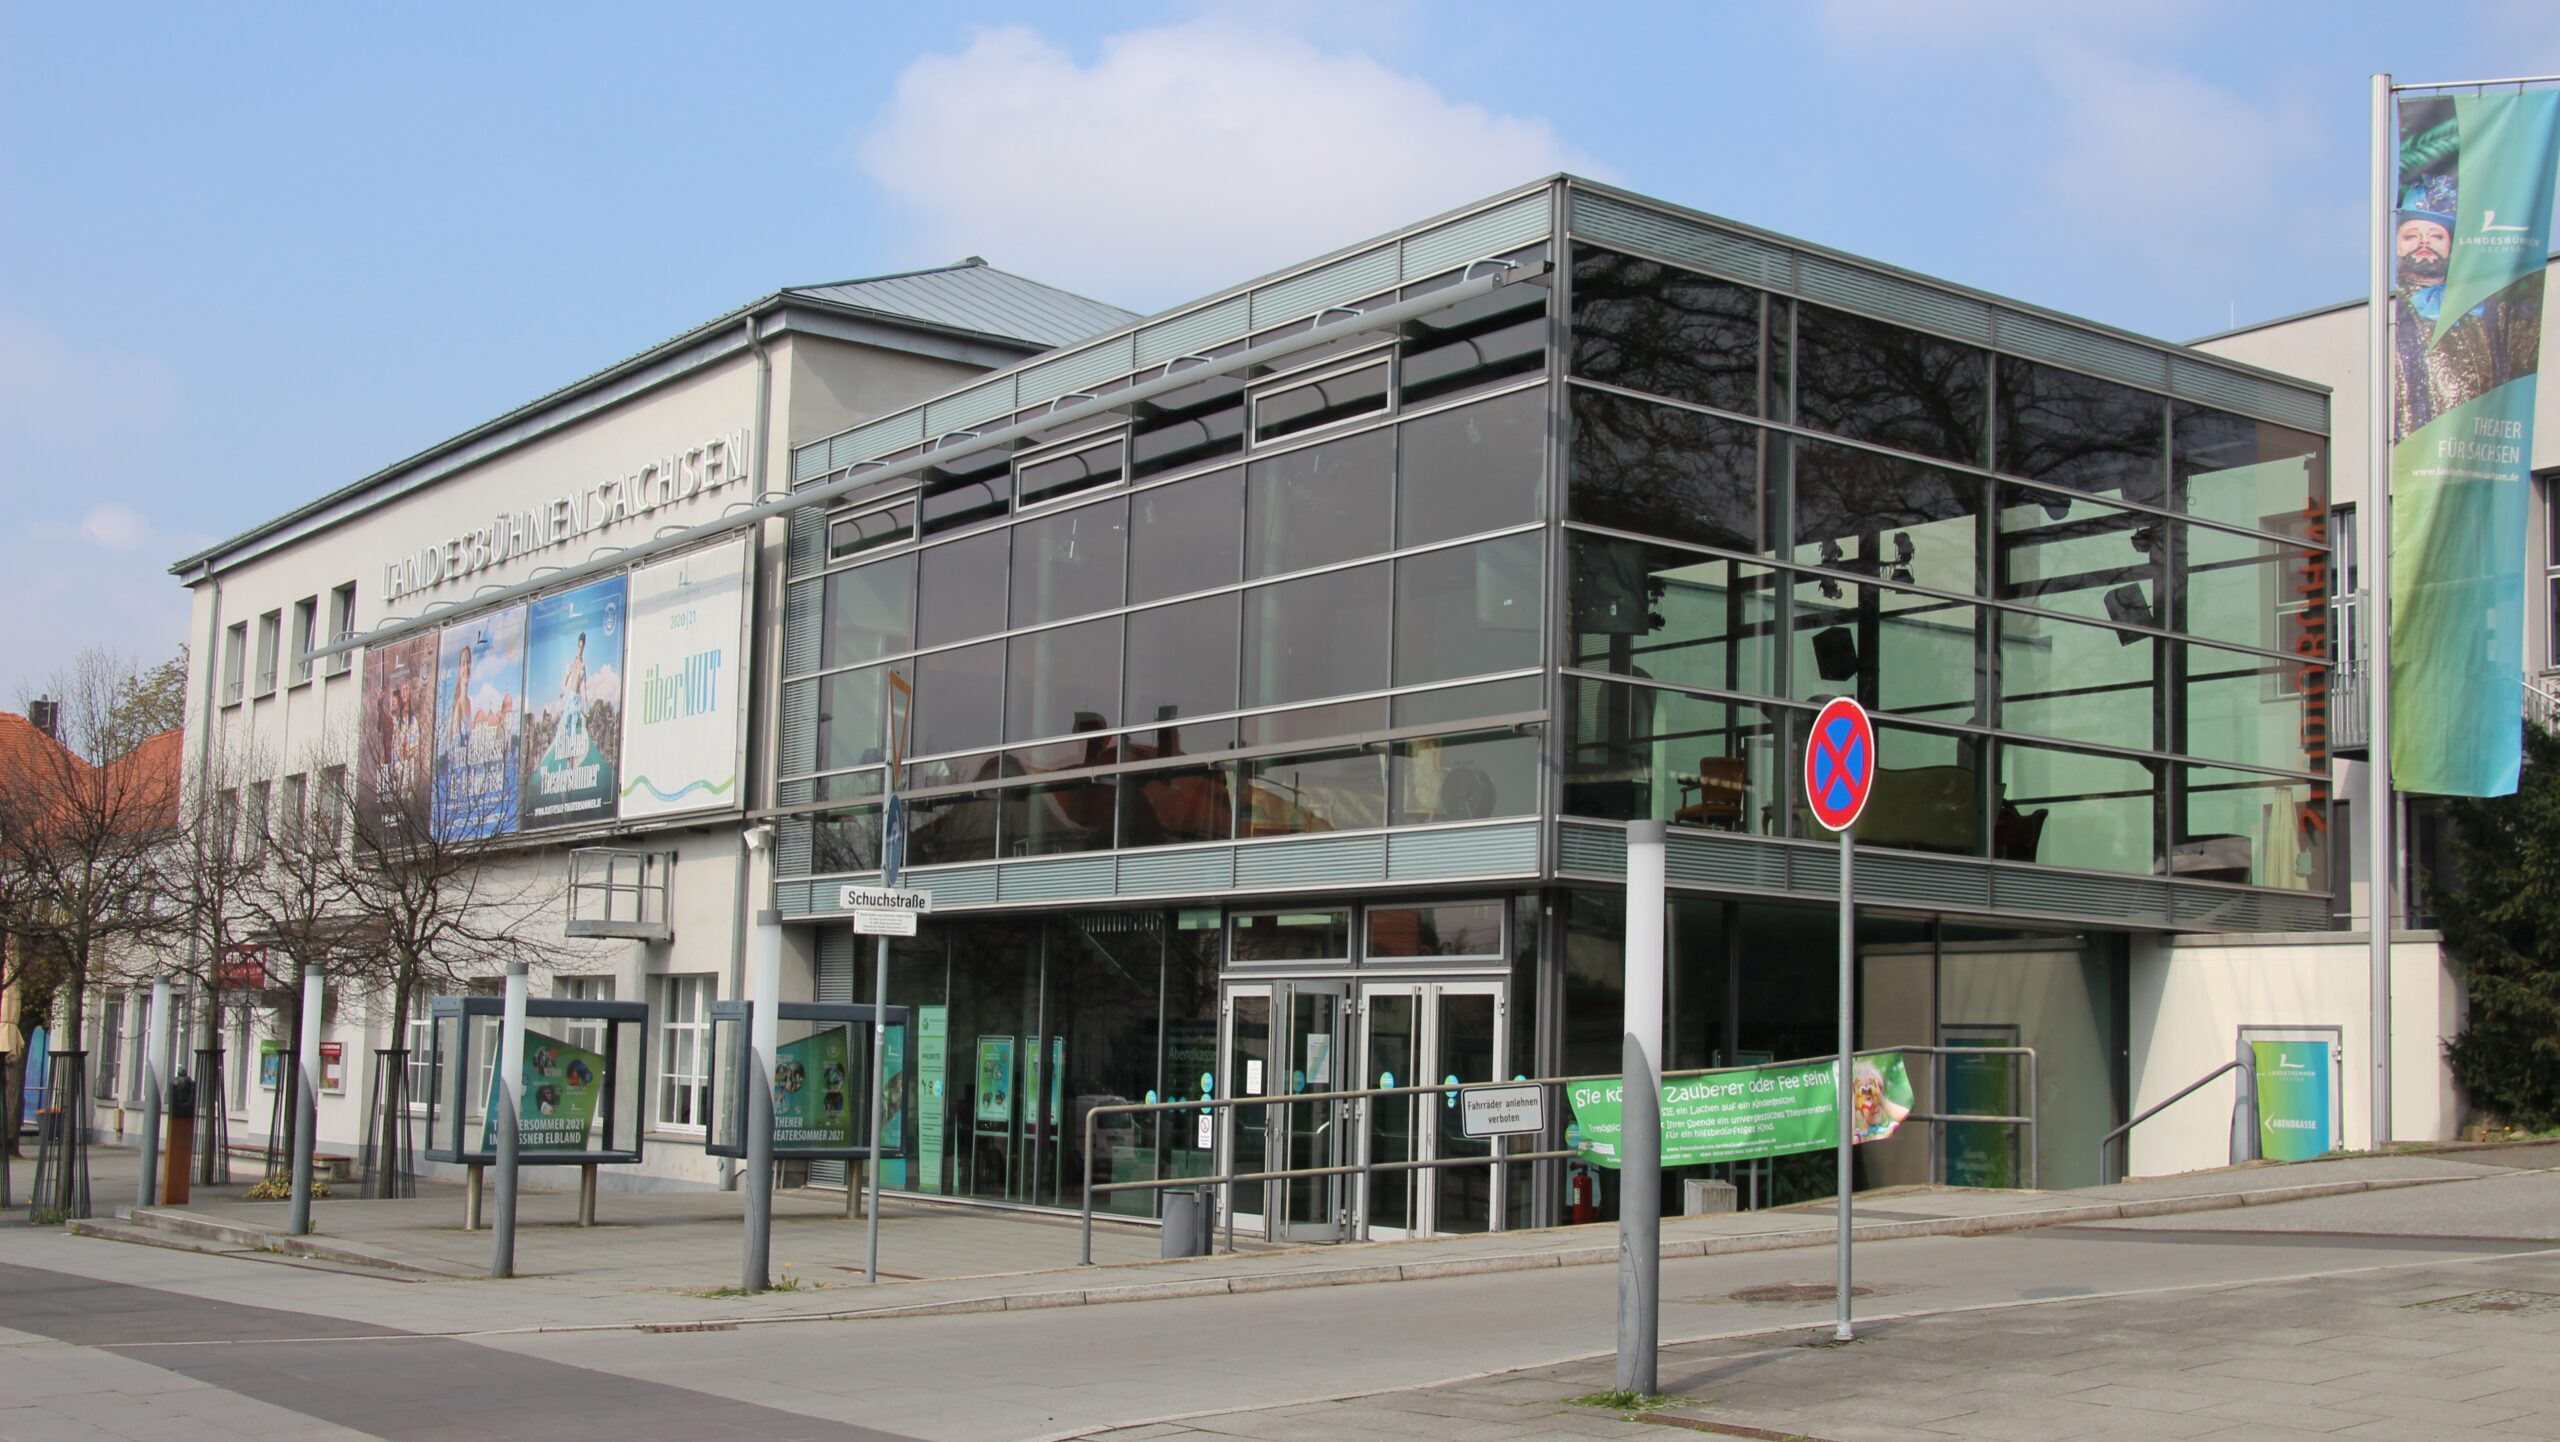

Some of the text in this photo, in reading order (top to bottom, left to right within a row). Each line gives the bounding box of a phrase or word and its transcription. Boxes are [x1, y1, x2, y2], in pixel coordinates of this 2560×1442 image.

[2473, 416, 2522, 439] THEATER
[2438, 436, 2520, 464] FÜR SACHSEN
[381, 428, 750, 602] LANDESBÜHNEN SACHSEN
[643, 648, 722, 726] überMUT
[848, 890, 926, 909] Schuchstraße
[1664, 1070, 1832, 1103] Zauberer oder Fee sein!
[1467, 1097, 1538, 1111] Fahrräder anlehnen
[1575, 1088, 1601, 1109] Sie
[1676, 1106, 1688, 1115] ein
[1689, 1105, 1719, 1115] Lachen
[1721, 1102, 1737, 1112] auf
[1738, 1099, 1750, 1110] ein
[493, 1118, 585, 1131] TERSOMMER 2021
[774, 1116, 803, 1128] THENER
[1488, 1113, 1520, 1124] verboten
[1666, 1120, 1685, 1130] Ihrer
[1687, 1117, 1716, 1129] Spende
[1717, 1117, 1729, 1125] ein
[2272, 1119, 2318, 1130] ABENDKASSE
[545, 1131, 581, 1144] ELBLAND
[828, 1129, 844, 1140] 2021
[1681, 1130, 1693, 1138] ein
[1757, 1122, 1775, 1133] Kind.
